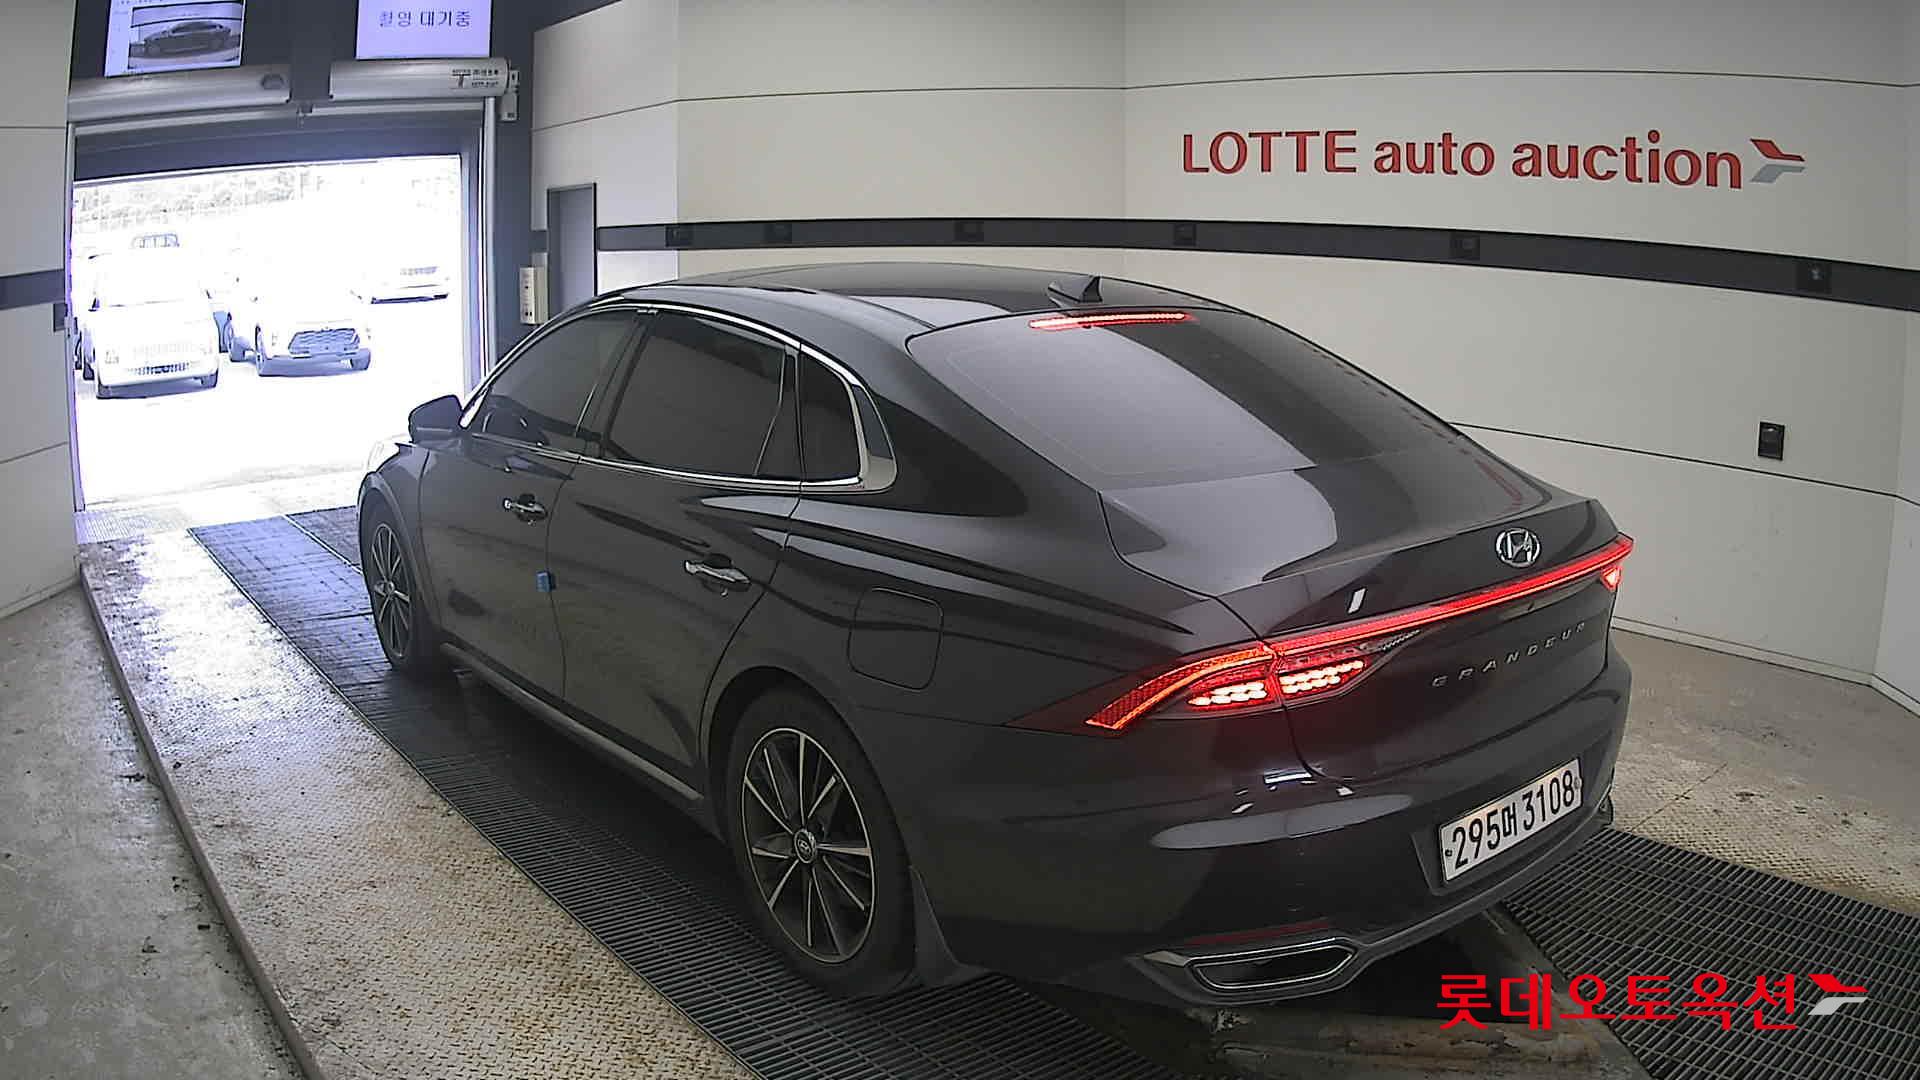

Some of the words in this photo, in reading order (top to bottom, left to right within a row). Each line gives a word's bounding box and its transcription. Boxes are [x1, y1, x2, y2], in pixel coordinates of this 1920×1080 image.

[420, 10, 471, 28] 대기중
[1183, 130, 1356, 174] LOTTE
[1375, 133, 1496, 177] auto
[1512, 130, 1743, 189] auction
[1431, 622, 1585, 687] GRANDEUR
[1452, 801, 1518, 870] 295머
[1521, 769, 1575, 831] 3108
